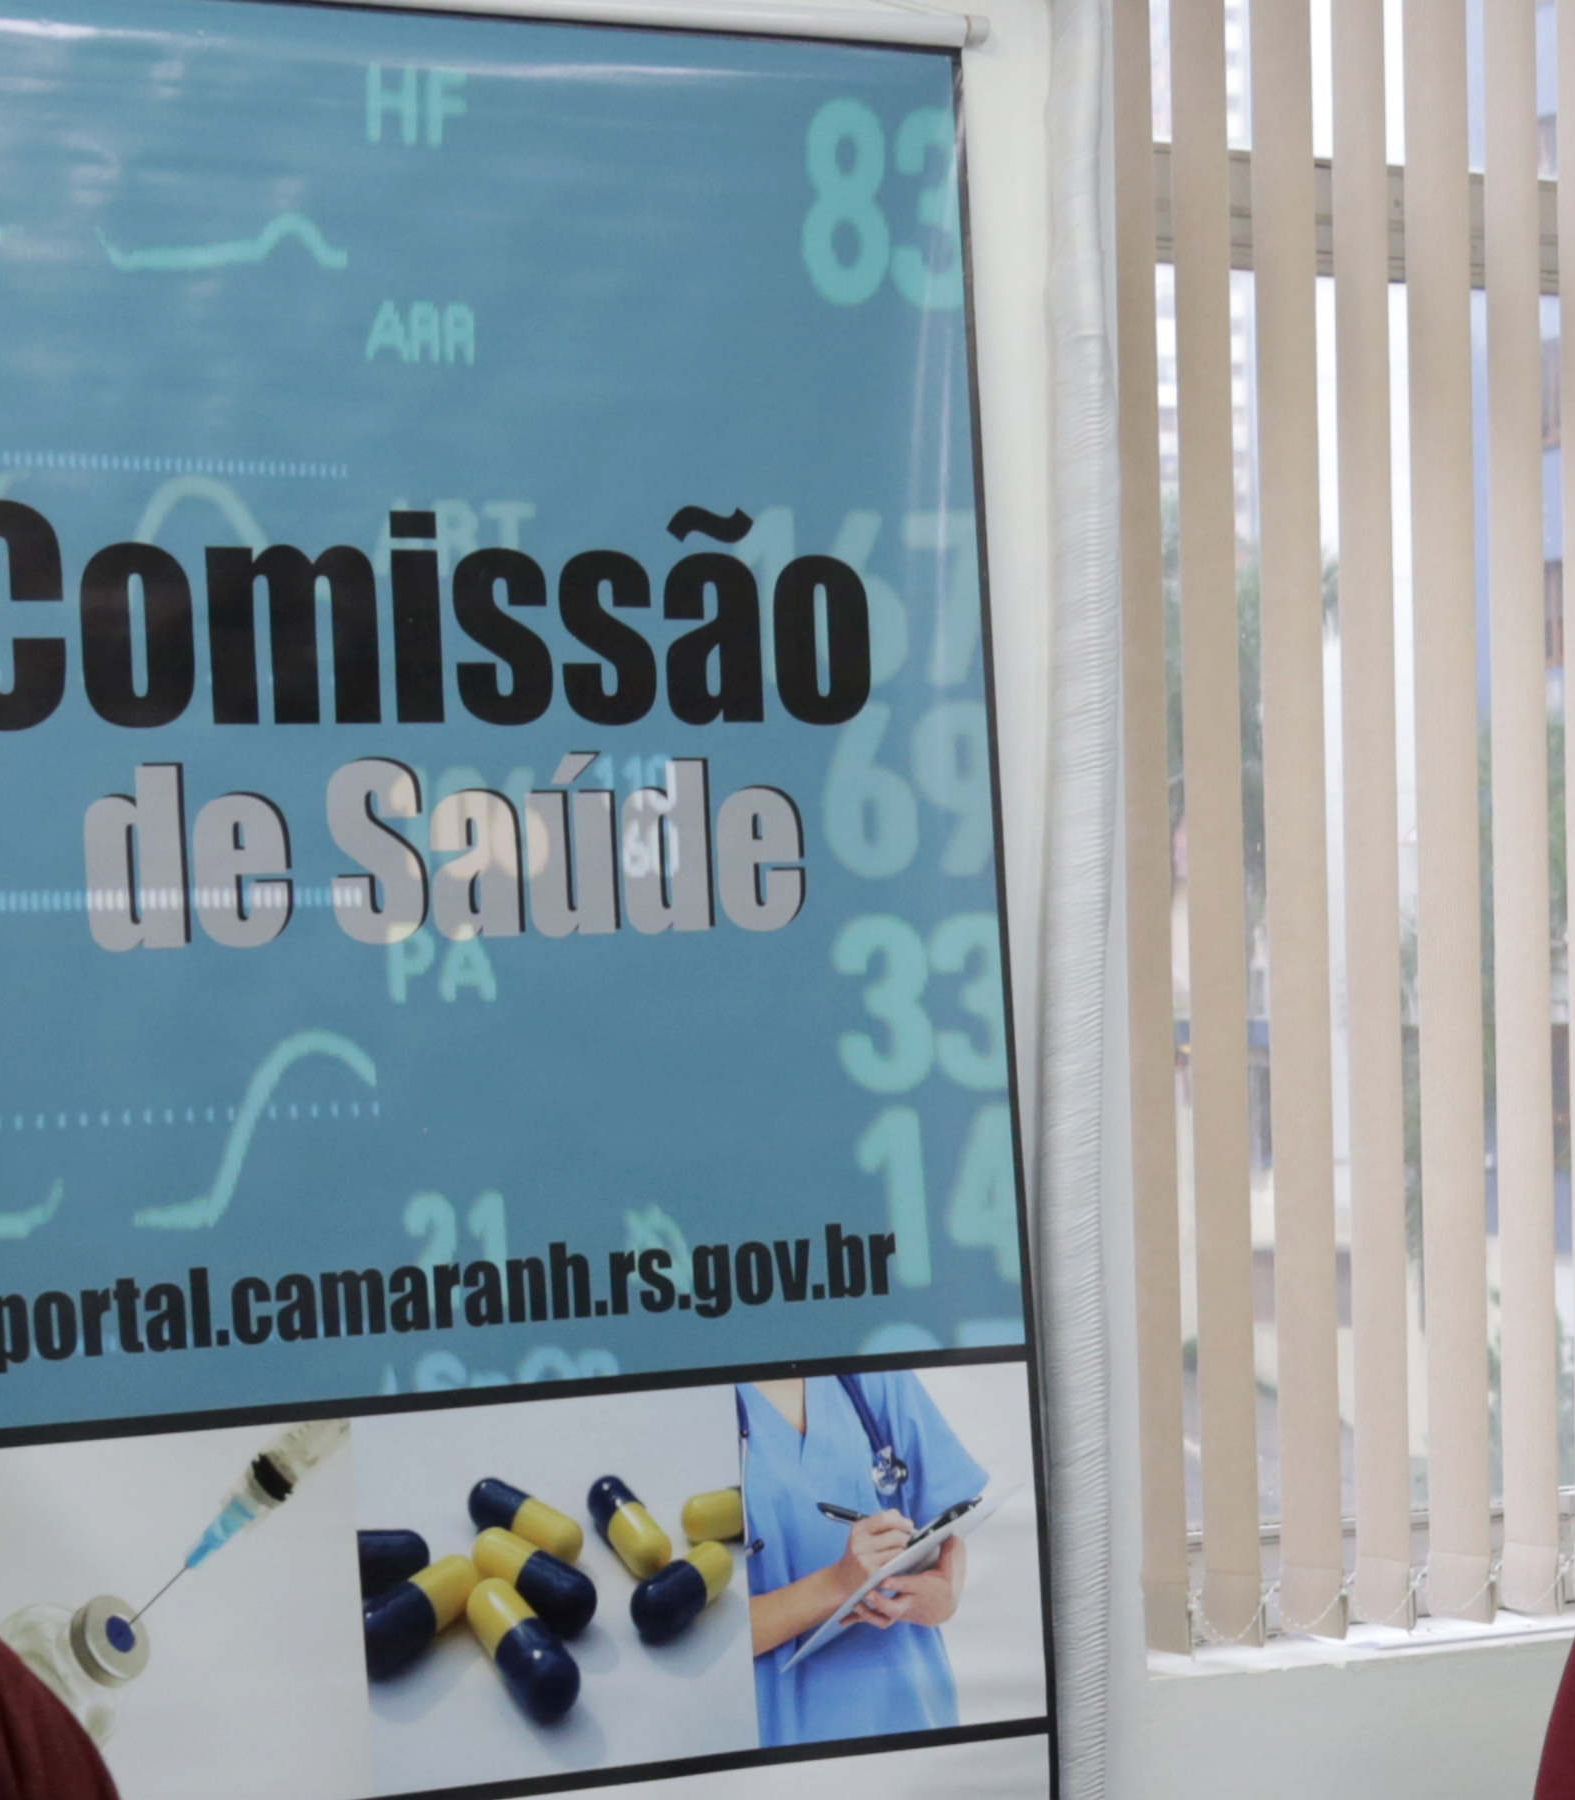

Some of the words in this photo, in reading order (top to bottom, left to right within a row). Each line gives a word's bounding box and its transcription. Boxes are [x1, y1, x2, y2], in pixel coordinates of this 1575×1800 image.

[367, 60, 467, 147] HF
[801, 96, 964, 311] 83
[83, 762, 292, 950] de
[326, 750, 807, 945] Saúde
[386, 922, 497, 1003] PA
[832, 911, 1009, 1095] 33
[855, 1103, 1021, 1287] 14
